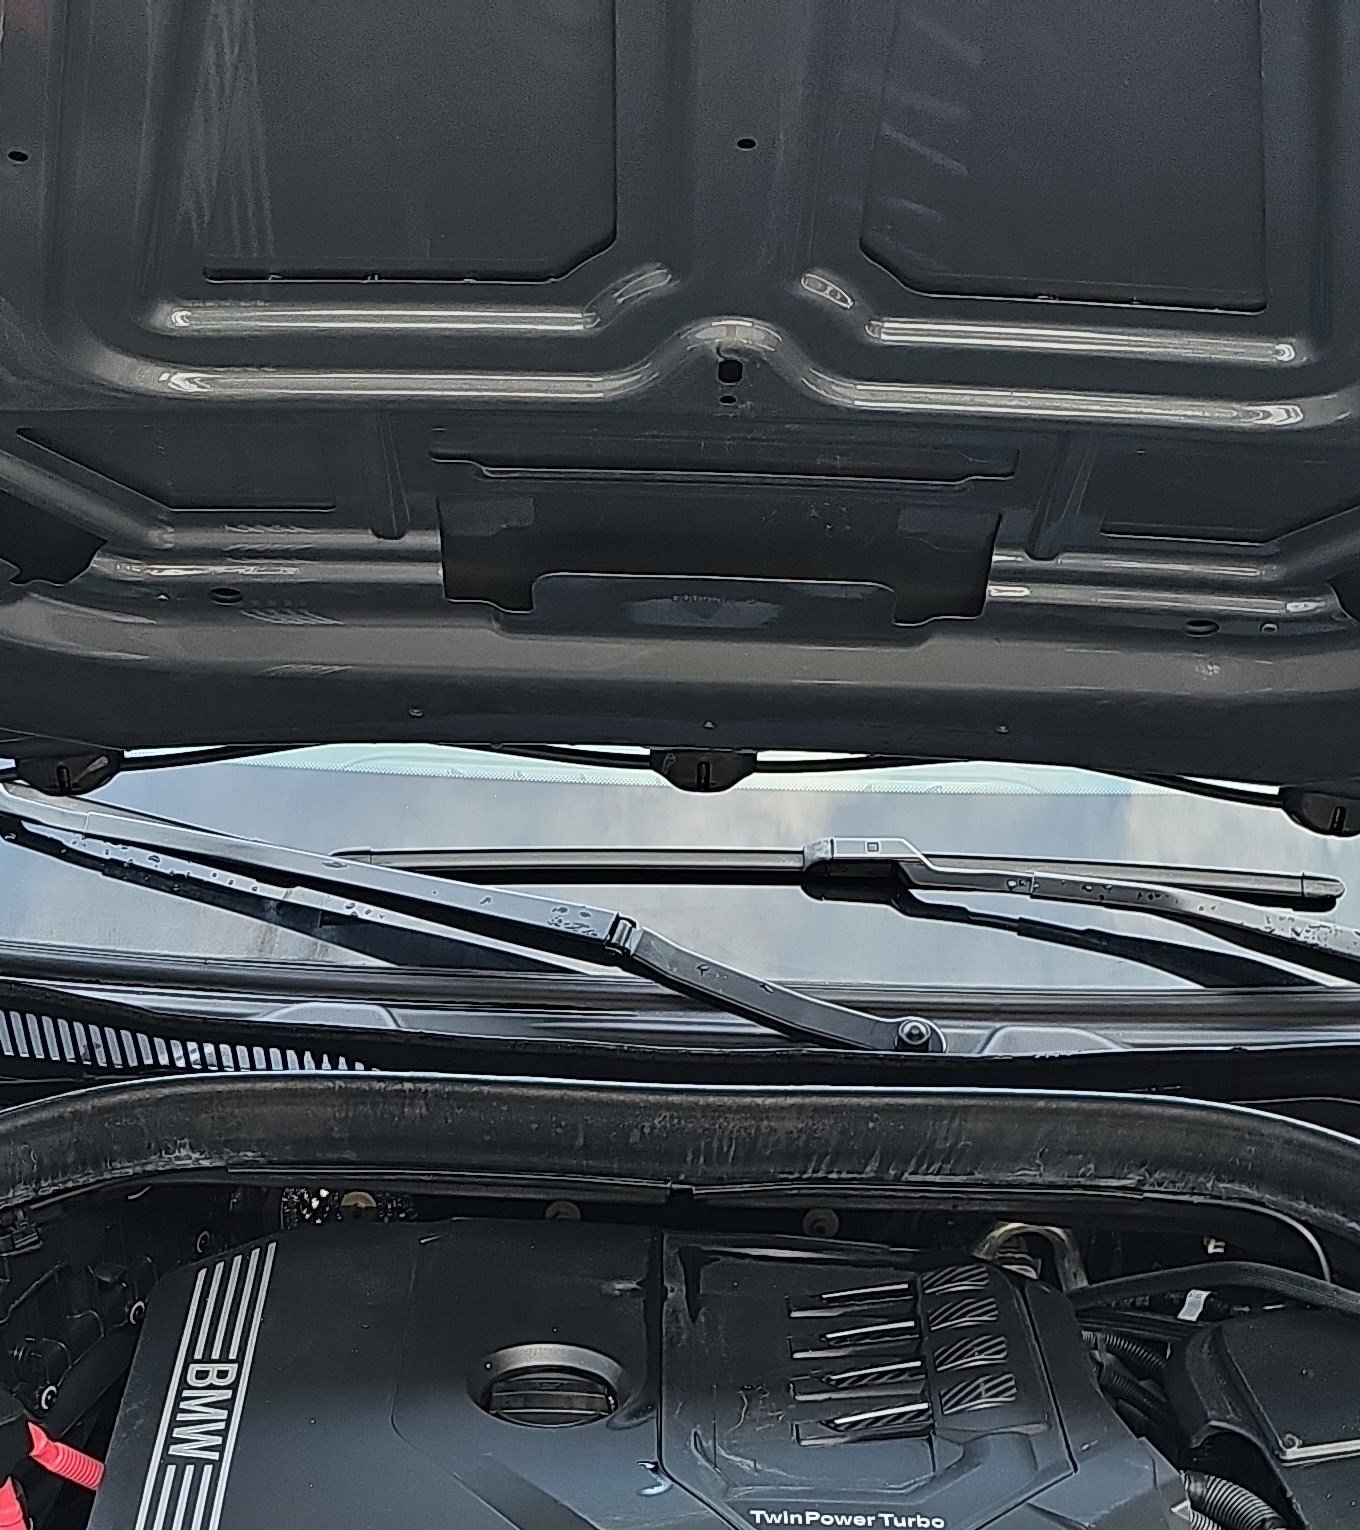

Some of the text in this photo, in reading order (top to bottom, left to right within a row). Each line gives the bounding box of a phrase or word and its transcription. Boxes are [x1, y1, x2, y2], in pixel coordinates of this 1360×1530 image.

[168, 1363, 238, 1461] BMW
[749, 1509, 945, 1529] TwinPower Turbo
